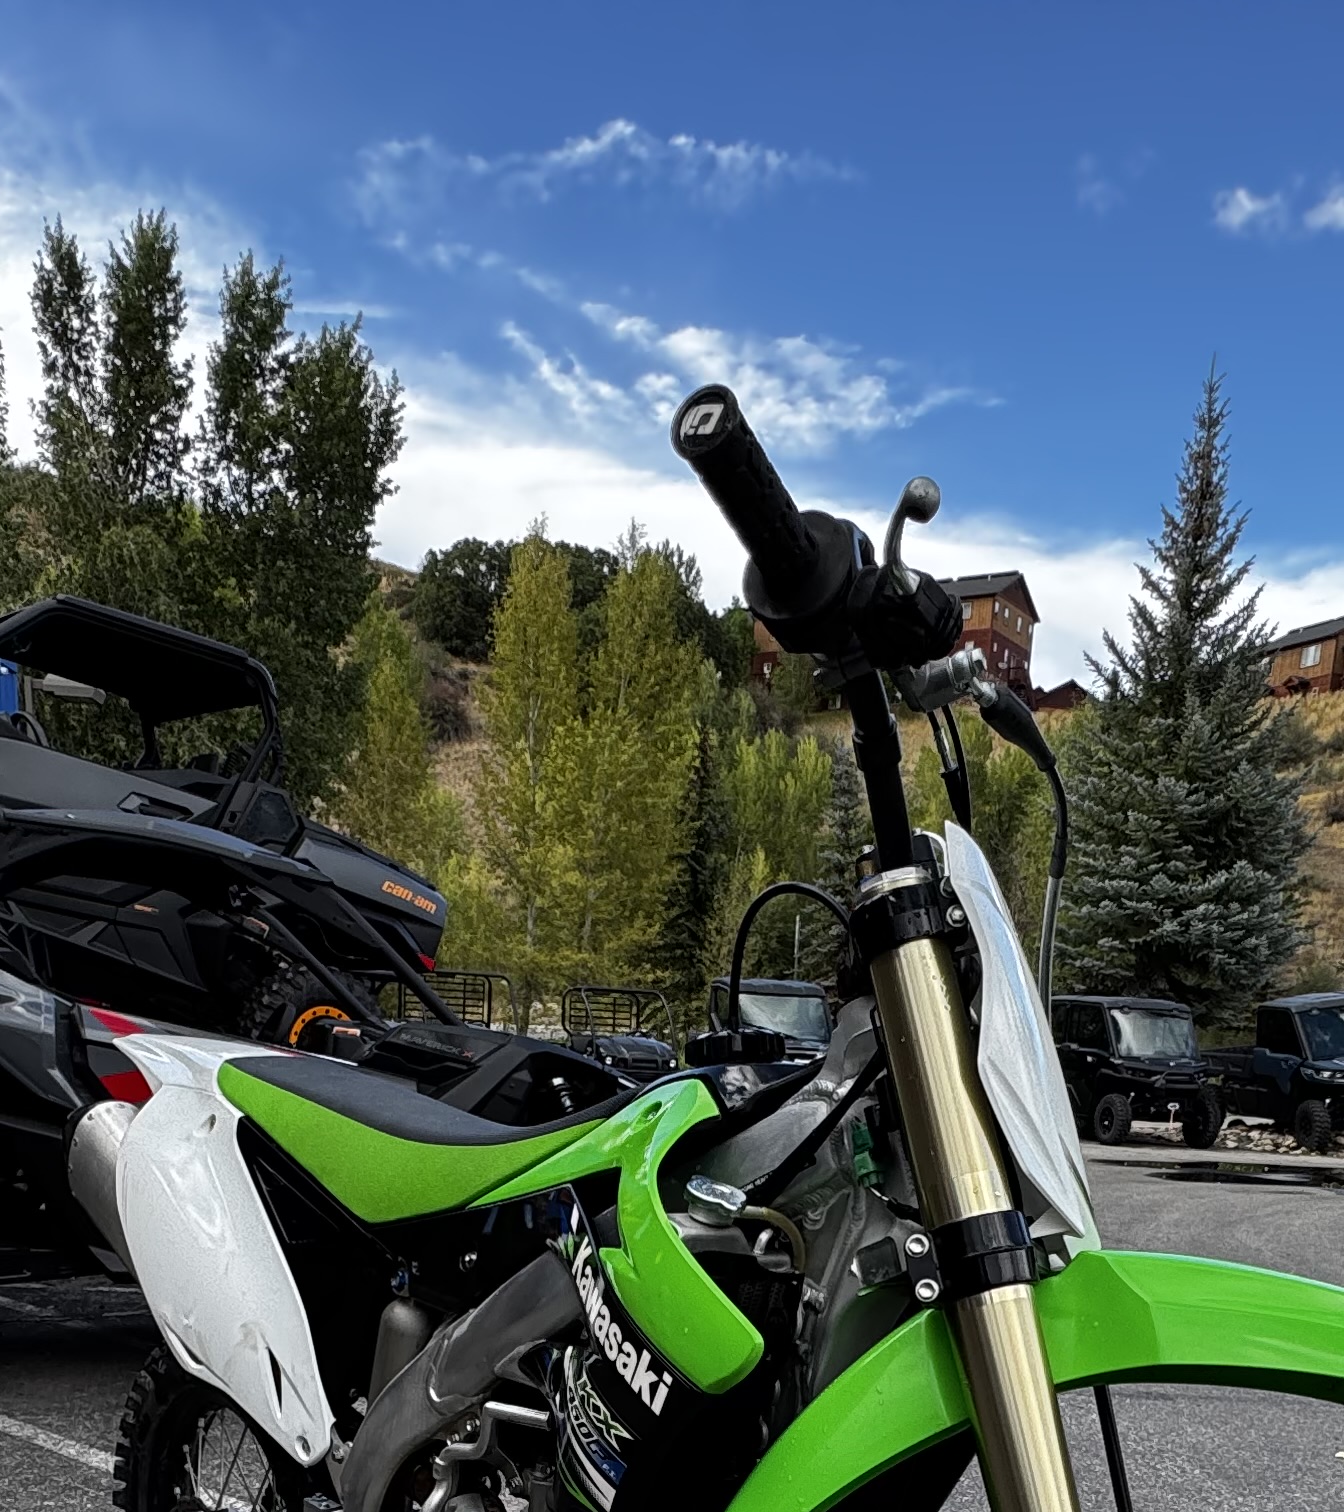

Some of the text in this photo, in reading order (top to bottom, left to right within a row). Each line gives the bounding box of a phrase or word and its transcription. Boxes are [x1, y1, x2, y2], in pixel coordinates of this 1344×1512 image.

[381, 880, 437, 915] can-am
[572, 1236, 673, 1417] Kawasaki
[576, 1375, 635, 1452] KX
